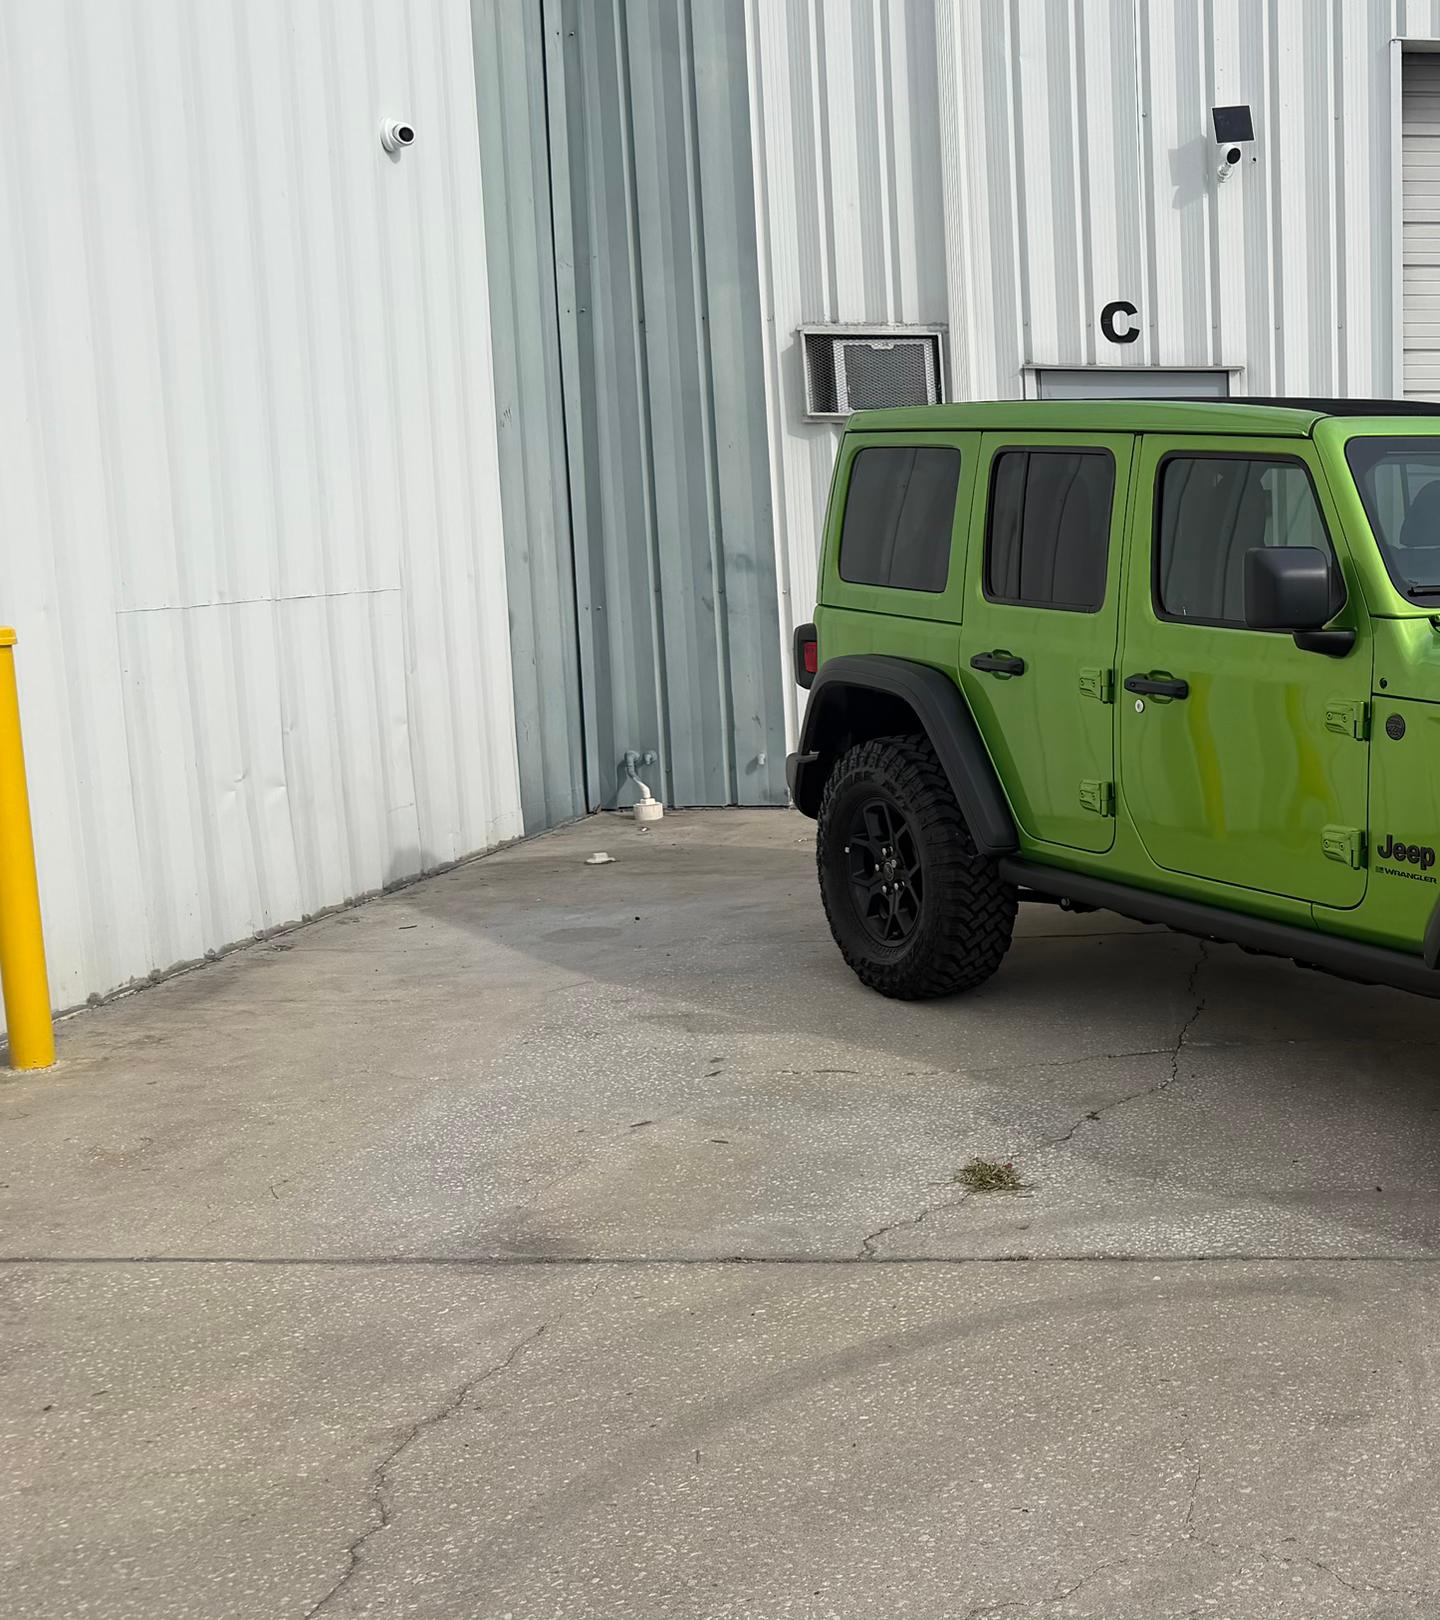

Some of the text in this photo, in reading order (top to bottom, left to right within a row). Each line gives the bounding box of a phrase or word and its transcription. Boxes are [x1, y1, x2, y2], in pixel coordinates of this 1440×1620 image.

[1100, 301, 1140, 343] C
[1377, 834, 1436, 870] Jeep
[1384, 867, 1437, 884] WRANGLER
